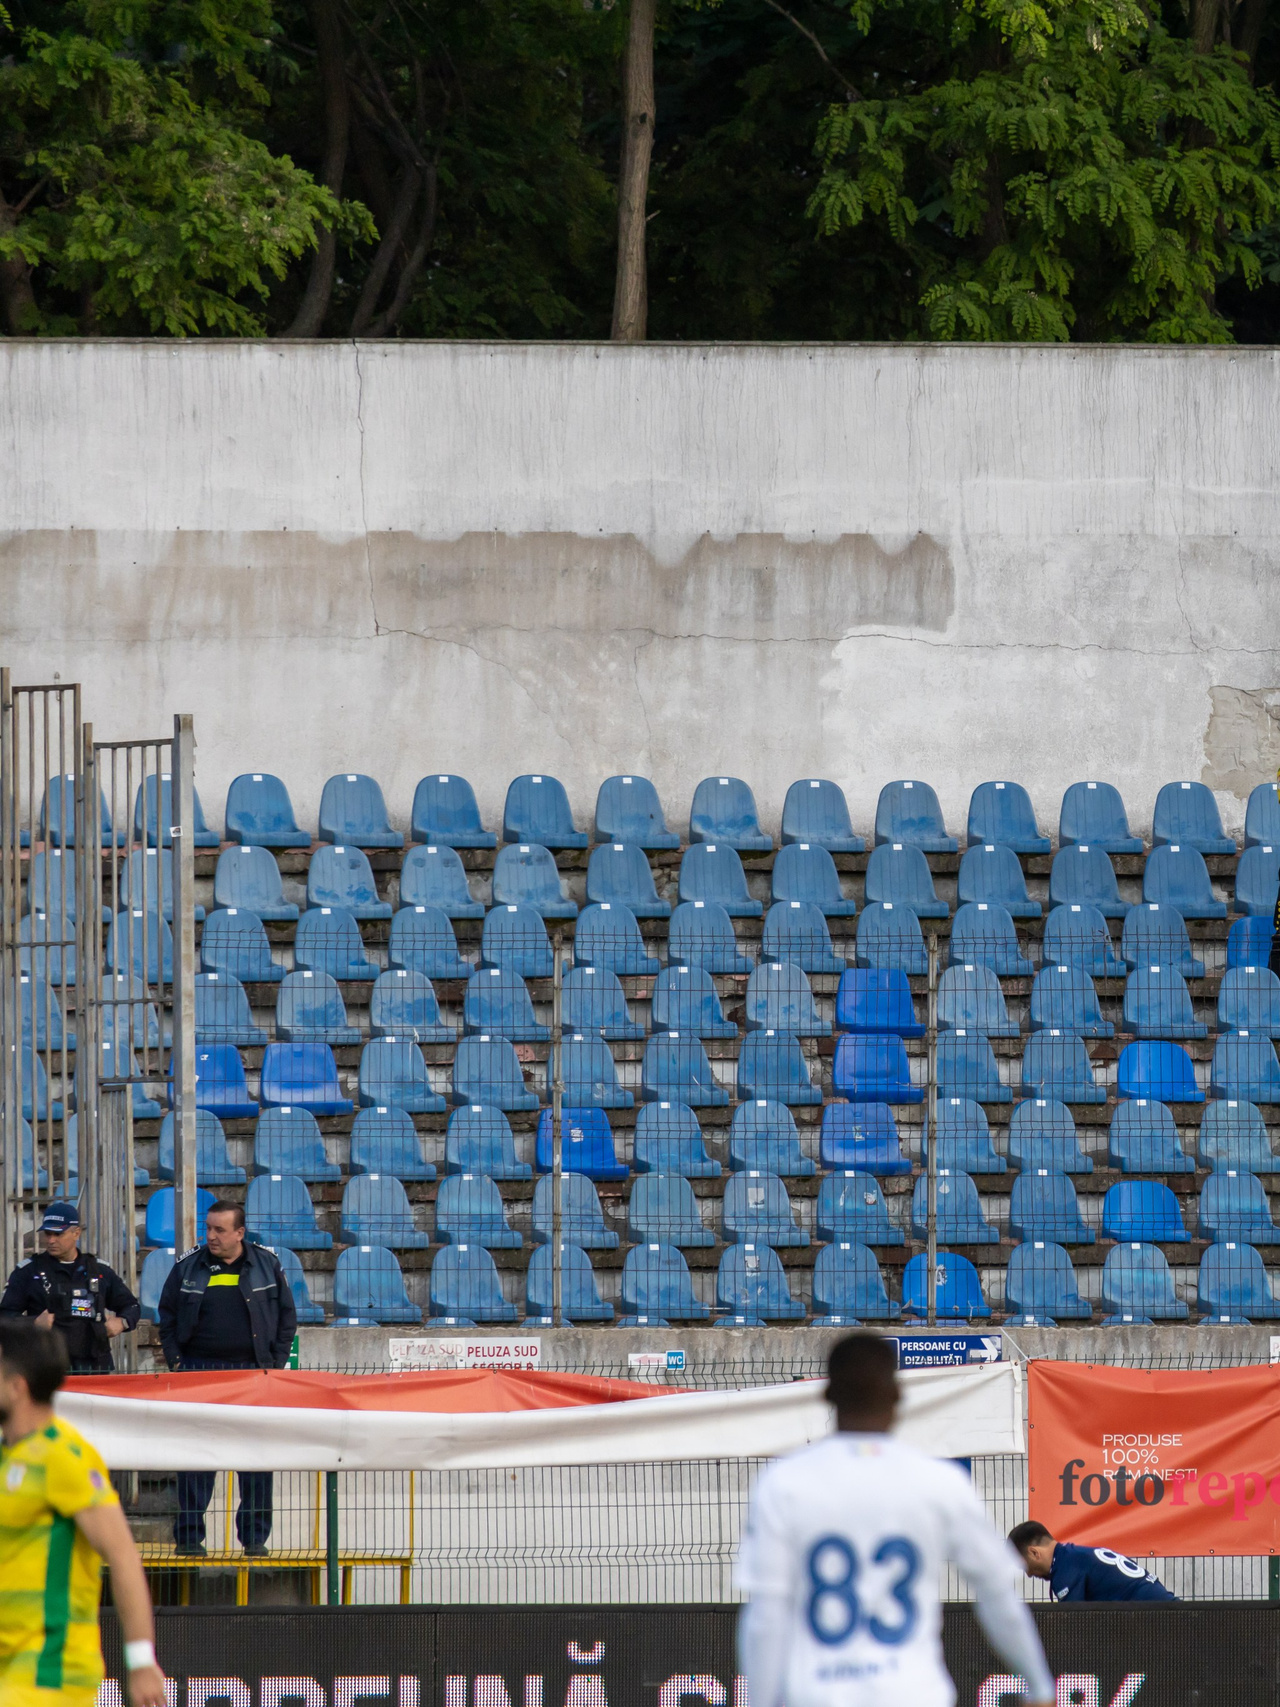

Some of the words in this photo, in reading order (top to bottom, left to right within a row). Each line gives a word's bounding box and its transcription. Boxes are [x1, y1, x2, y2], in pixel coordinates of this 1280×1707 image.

[467, 1346, 511, 1357] PELUZA
[514, 1345, 538, 1357] SUD
[901, 1341, 951, 1351] PERSOANE
[953, 1341, 966, 1350] CU
[668, 1355, 683, 1365] WC
[1102, 1434, 1183, 1447] PRODUSE
[1102, 1449, 1159, 1465] 100%
[807, 1534, 921, 1647] 83
